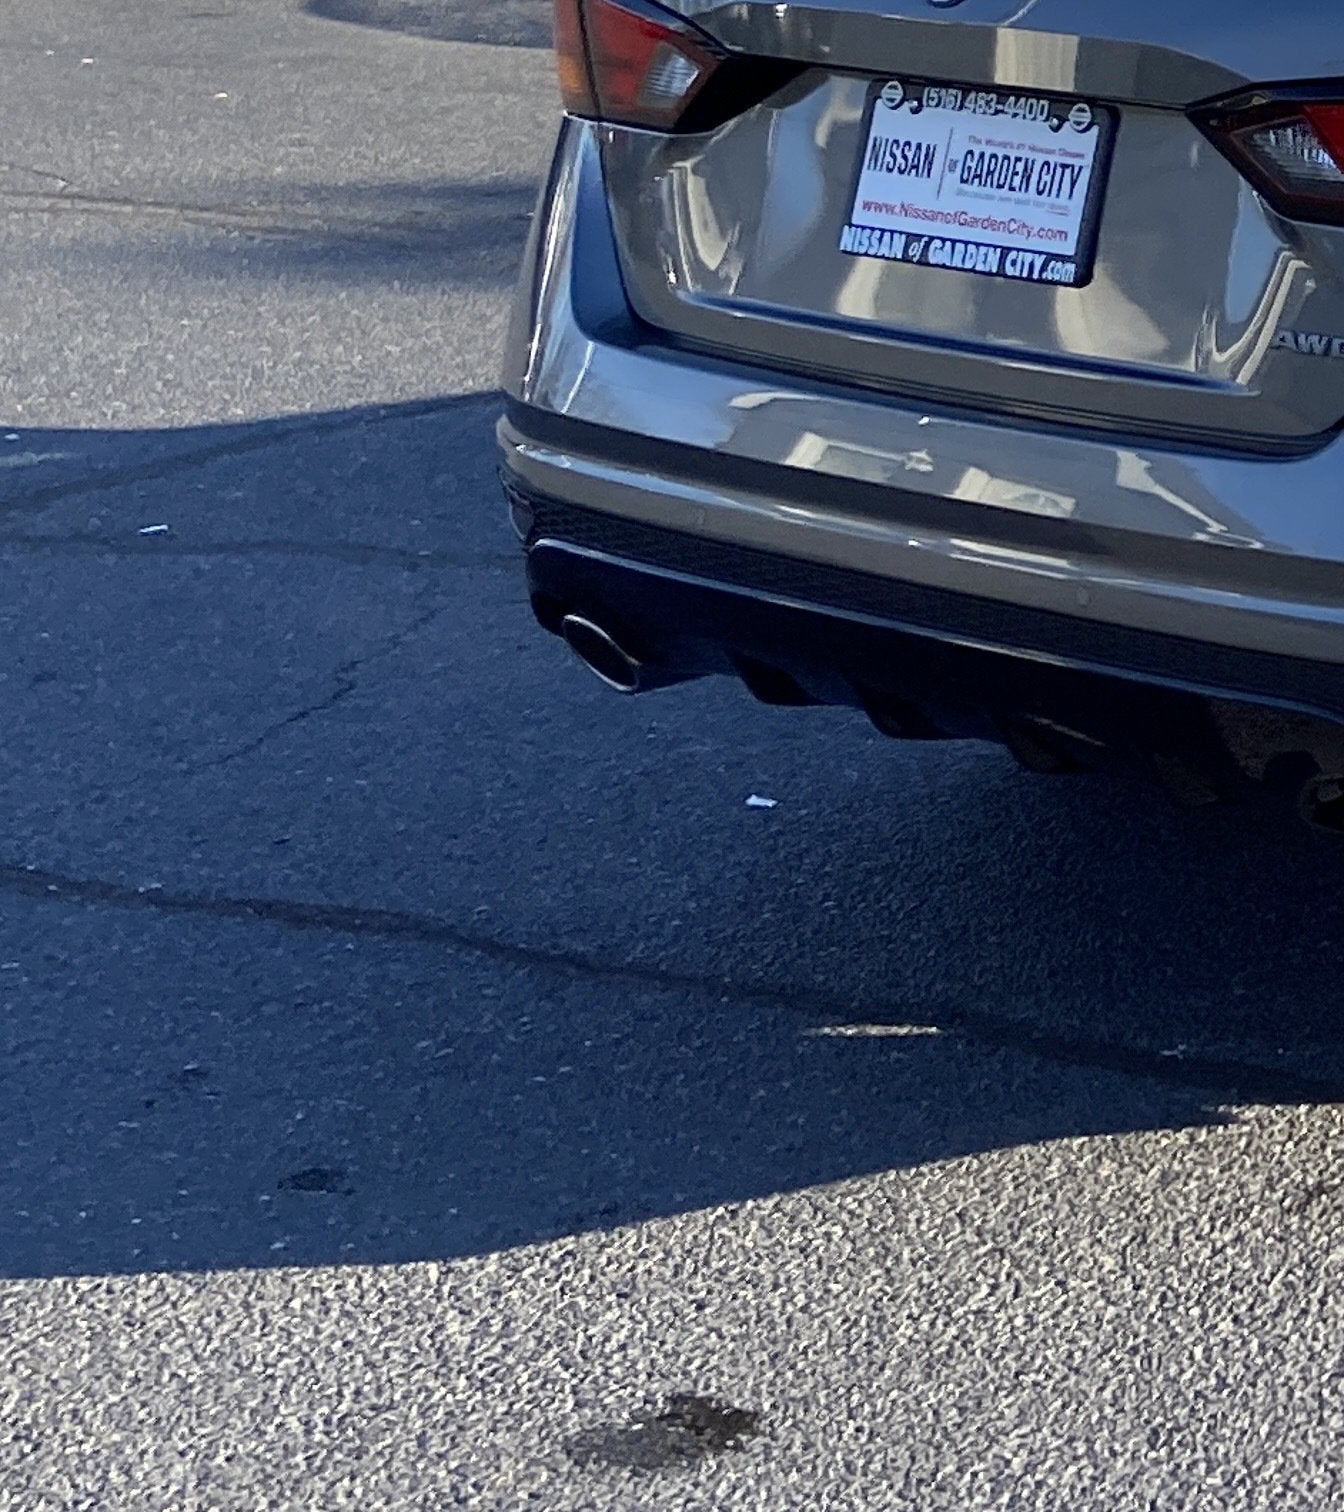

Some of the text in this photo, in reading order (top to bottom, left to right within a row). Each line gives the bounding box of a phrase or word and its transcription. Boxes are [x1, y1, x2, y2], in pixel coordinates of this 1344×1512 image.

[964, 90, 1049, 122] 483-4400
[867, 136, 937, 179] NISSAN
[959, 149, 1036, 193] GARDEN
[1036, 160, 1084, 200] CITY
[862, 200, 1069, 242] www.NissanofGardenCity.com
[840, 224, 906, 259] NISSAN
[908, 236, 928, 263] of
[928, 239, 1000, 274] GARDEN
